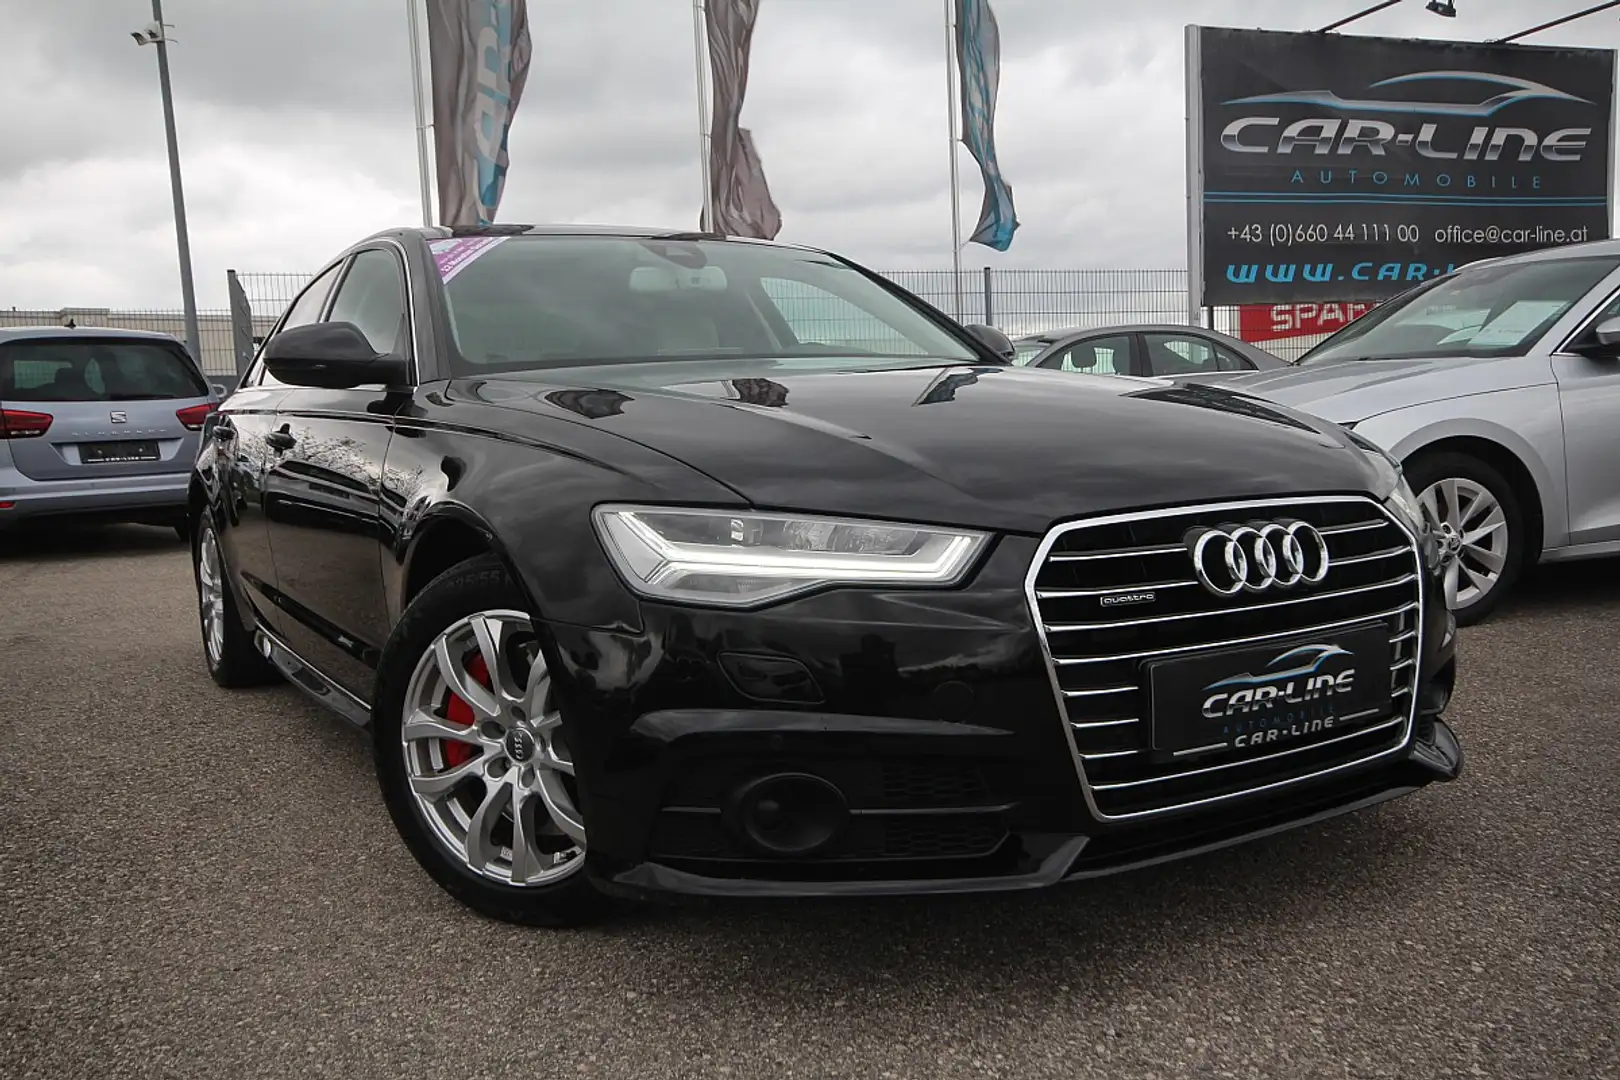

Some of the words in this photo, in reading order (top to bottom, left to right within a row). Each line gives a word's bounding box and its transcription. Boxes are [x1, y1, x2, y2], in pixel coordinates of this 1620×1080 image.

[1220, 117, 1592, 162] CAR-LINE
[1290, 169, 1542, 190] AUTOMOBILE
[1227, 223, 1264, 243] +43
[1269, 223, 1329, 247] (0)660
[1333, 223, 1355, 242] 44
[1361, 223, 1390, 242] 111
[1397, 224, 1420, 243] 00
[1434, 225, 1589, 243] office@car-line.at
[1103, 593, 1154, 605] quattro
[1201, 668, 1356, 719] CAR-LINE
[1234, 715, 1335, 748] CAR-LINE
